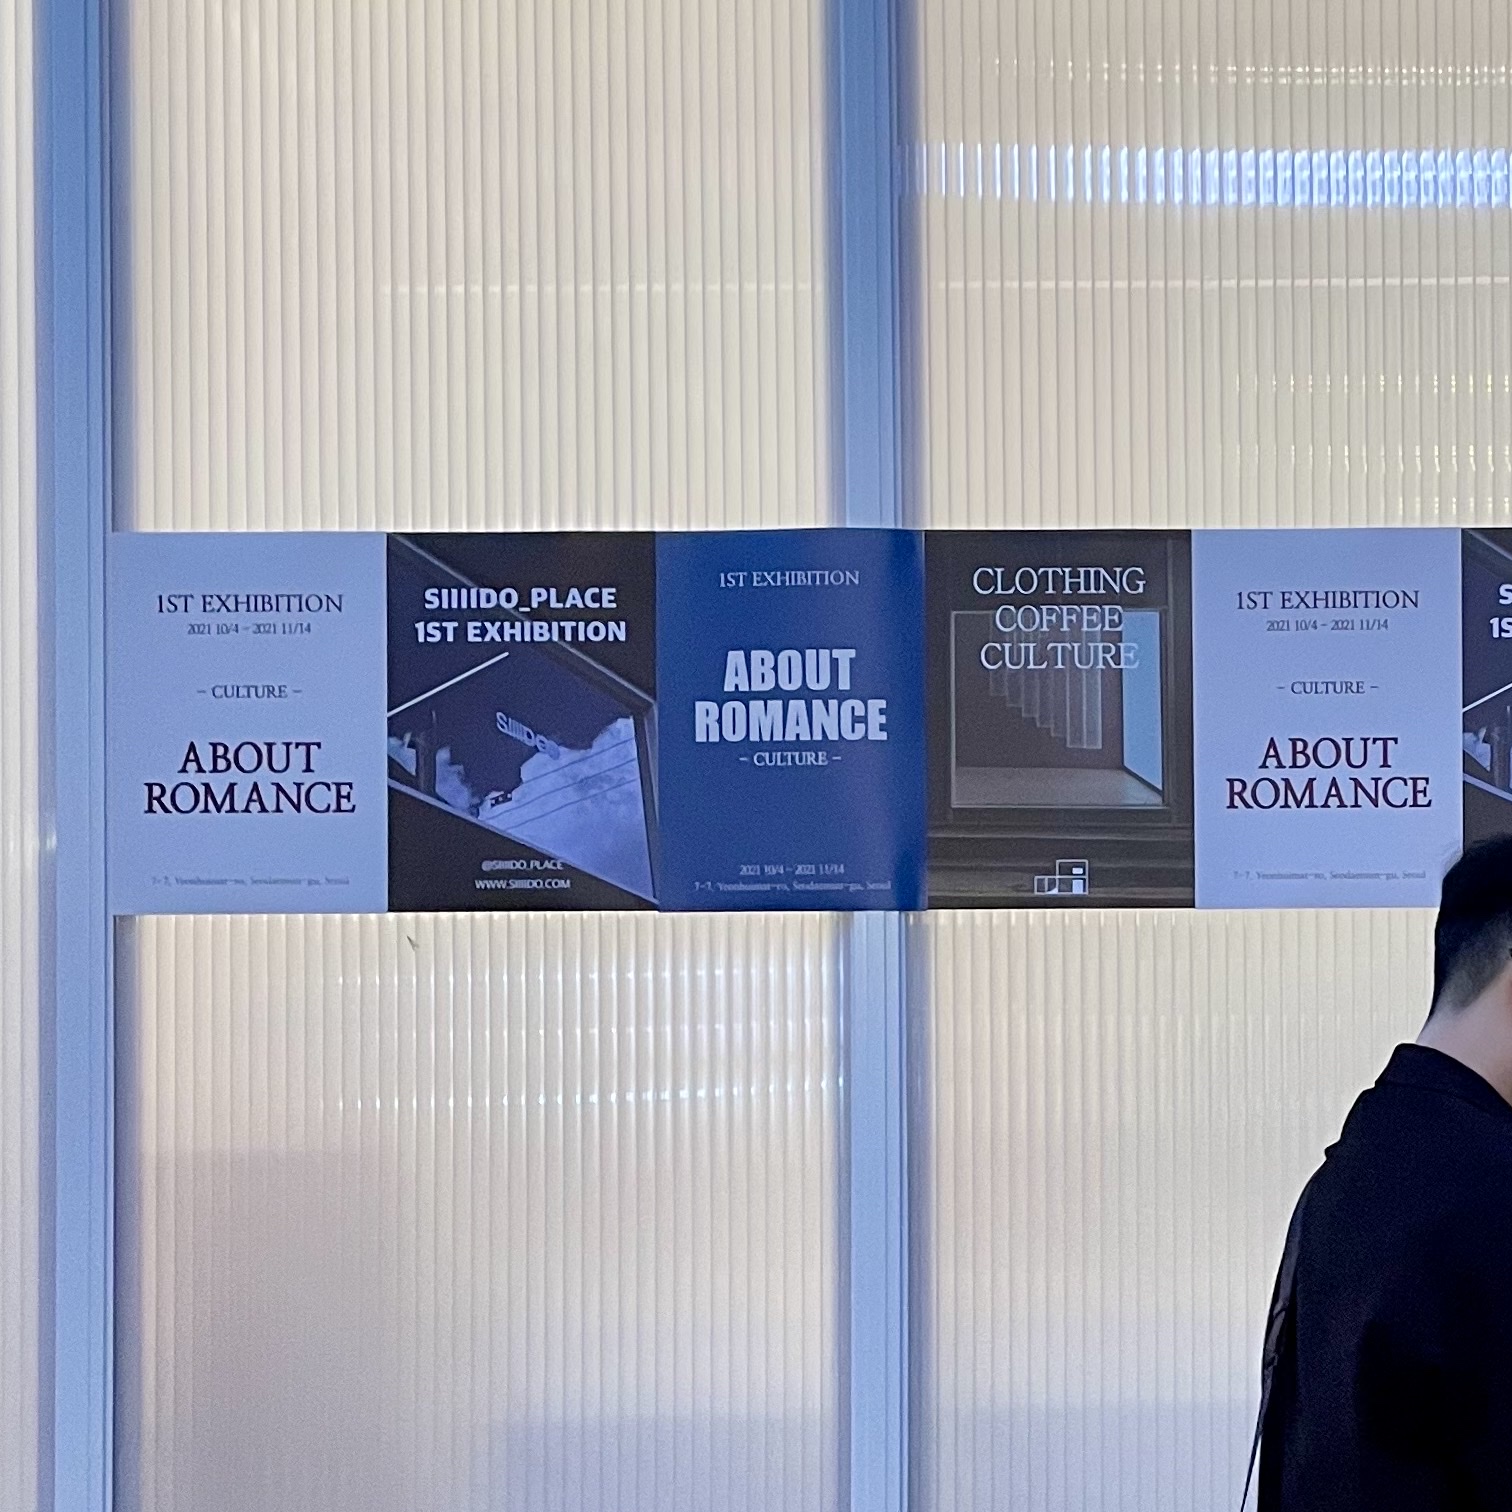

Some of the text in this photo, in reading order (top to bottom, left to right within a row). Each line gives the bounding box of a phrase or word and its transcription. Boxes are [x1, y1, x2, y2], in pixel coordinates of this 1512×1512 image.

[719, 569, 859, 589] 1ST EXHIBITION
[972, 567, 1146, 596] CLOTHING
[157, 594, 343, 613] 1ST EXHIBITION
[424, 587, 617, 612] SIIIIDO_PLACE
[1236, 590, 1419, 610] 1ST EXHIBITION
[188, 623, 211, 635] 2021
[253, 623, 277, 634] 2021
[994, 604, 1124, 633] COFFEE
[1266, 621, 1290, 632] 2021
[1295, 620, 1318, 631] 10/4
[1331, 619, 1354, 631] 2021
[1359, 619, 1389, 631] 11/14
[415, 621, 626, 643] 1ST EXHIBITION
[980, 642, 1140, 670] CULTURE
[723, 648, 856, 692] ABOUT
[212, 685, 288, 699] CULTURE
[1291, 681, 1365, 695] CULTURE
[694, 699, 888, 743] ROMANCE
[177, 741, 322, 775] ABOUT
[753, 751, 828, 767] CULTURE
[1259, 737, 1399, 770] ABOUT
[143, 782, 356, 815] ROMANCE
[1225, 776, 1433, 811] ROMANCE
